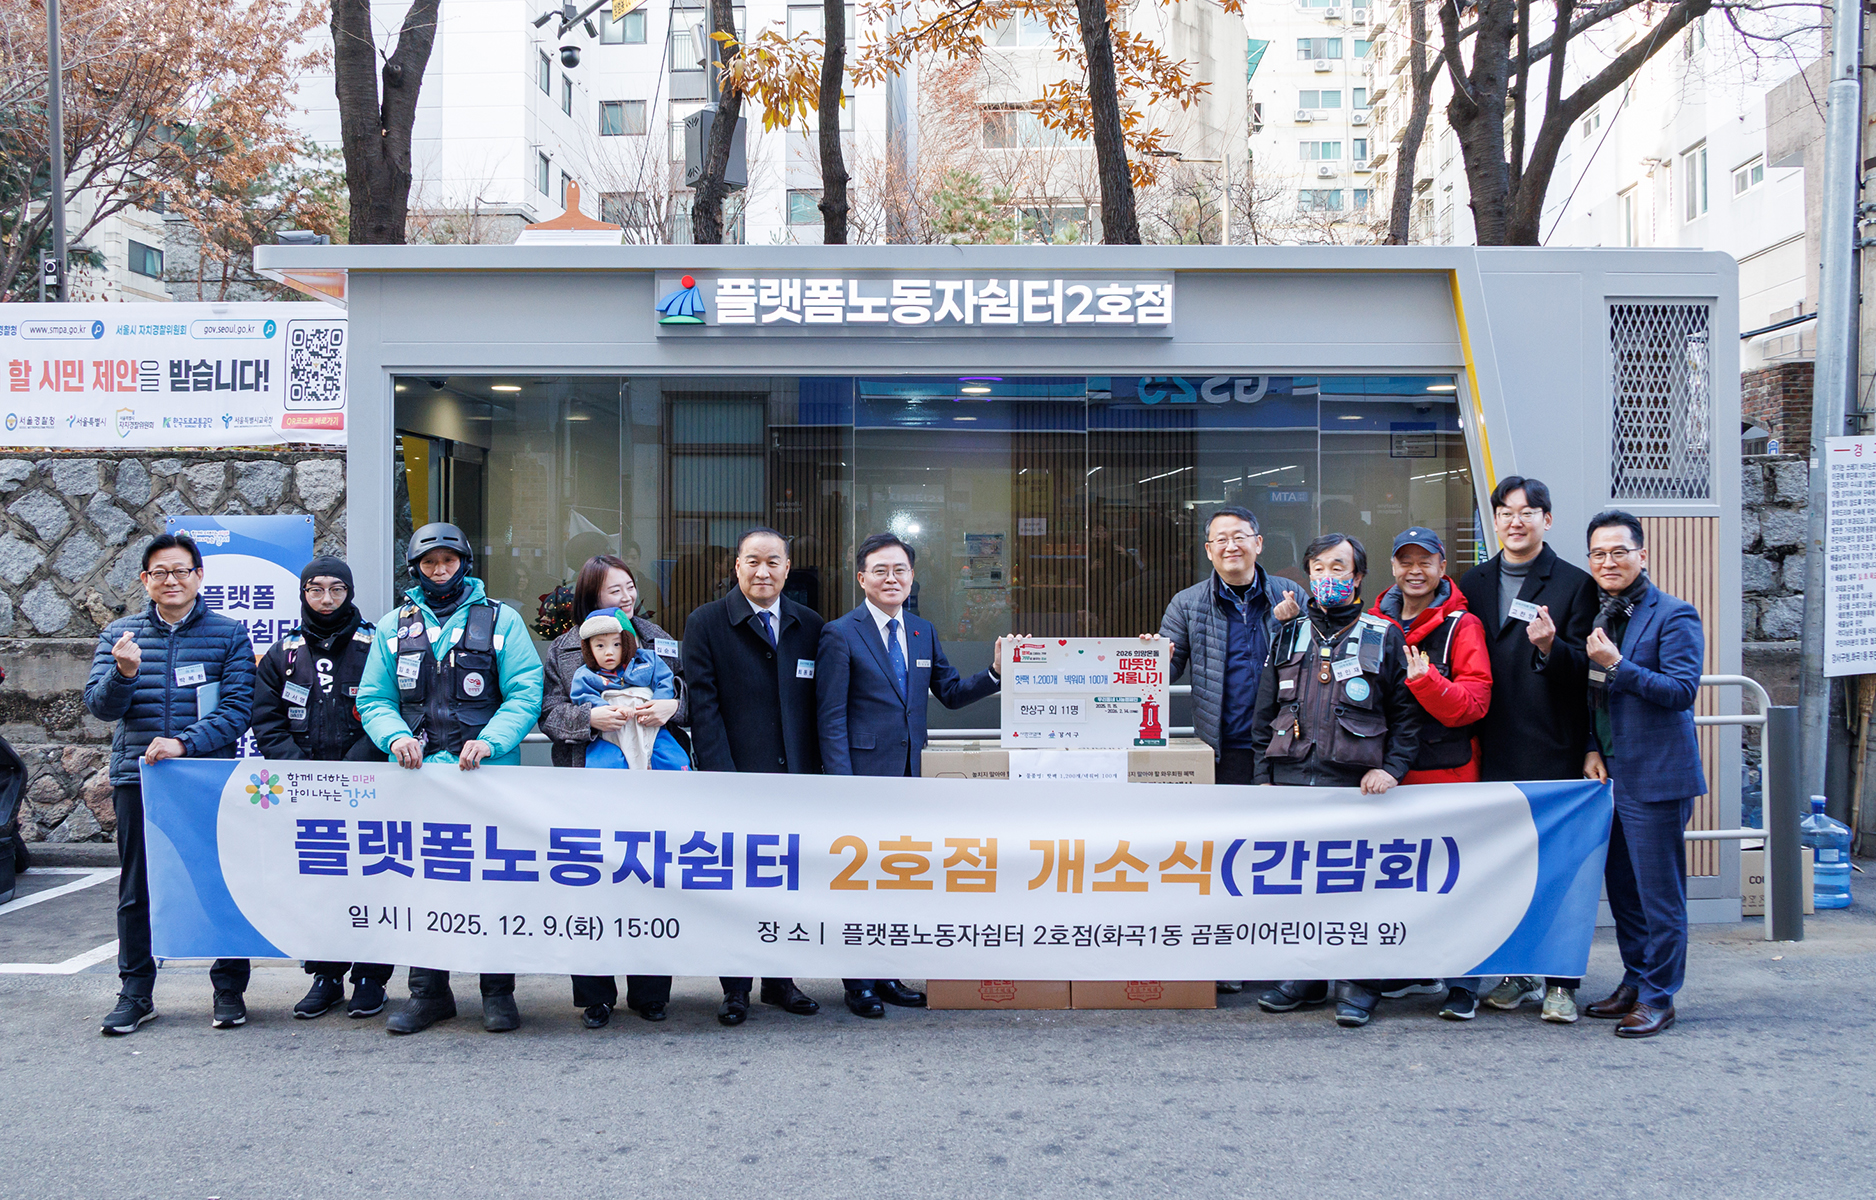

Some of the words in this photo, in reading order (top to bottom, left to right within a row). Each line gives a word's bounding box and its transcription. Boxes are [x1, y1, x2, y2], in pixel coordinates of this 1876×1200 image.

[714, 277, 1173, 326] 플랫폼노동자쉼터2호점
[29, 324, 86, 335] www.smpa.go.kr
[116, 324, 136, 336] 서울시
[138, 324, 187, 336] 자치경찰위원회
[203, 323, 255, 335] gov.seoul.go.kr
[8, 359, 32, 392] 할
[38, 359, 84, 392] 시민
[92, 359, 161, 392] 제안을
[169, 359, 270, 392] 받습니다!
[76, 417, 106, 428] 서울특별시
[203, 584, 276, 611] 플랫폼
[1119, 658, 1157, 670] 따뜻한
[1089, 675, 1108, 684] 100개
[1113, 672, 1162, 684] 겨울나기
[1020, 705, 1045, 715] 한상구
[1062, 705, 1078, 715] 11명
[287, 772, 313, 787] 함께
[317, 774, 350, 787] 더하는
[352, 774, 375, 784] 미래
[288, 789, 310, 803] 같이
[312, 789, 342, 802] 나누는
[344, 788, 376, 808] 강서
[295, 818, 800, 892] 플랫폼노동자쉼터
[829, 835, 998, 893] 2호점
[1027, 837, 1461, 897] 개소식(간담회)
[426, 911, 488, 936] 2025.
[499, 915, 533, 937] 12.
[543, 914, 604, 941] 9.(화)
[613, 917, 680, 938] 15:00
[842, 922, 1024, 948] 플랫폼노동자쉼터
[1033, 923, 1182, 948] 2호점(화곡1동
[1190, 922, 1368, 946] 곰돌이어린이공원
[1378, 922, 1407, 946] 앞)
